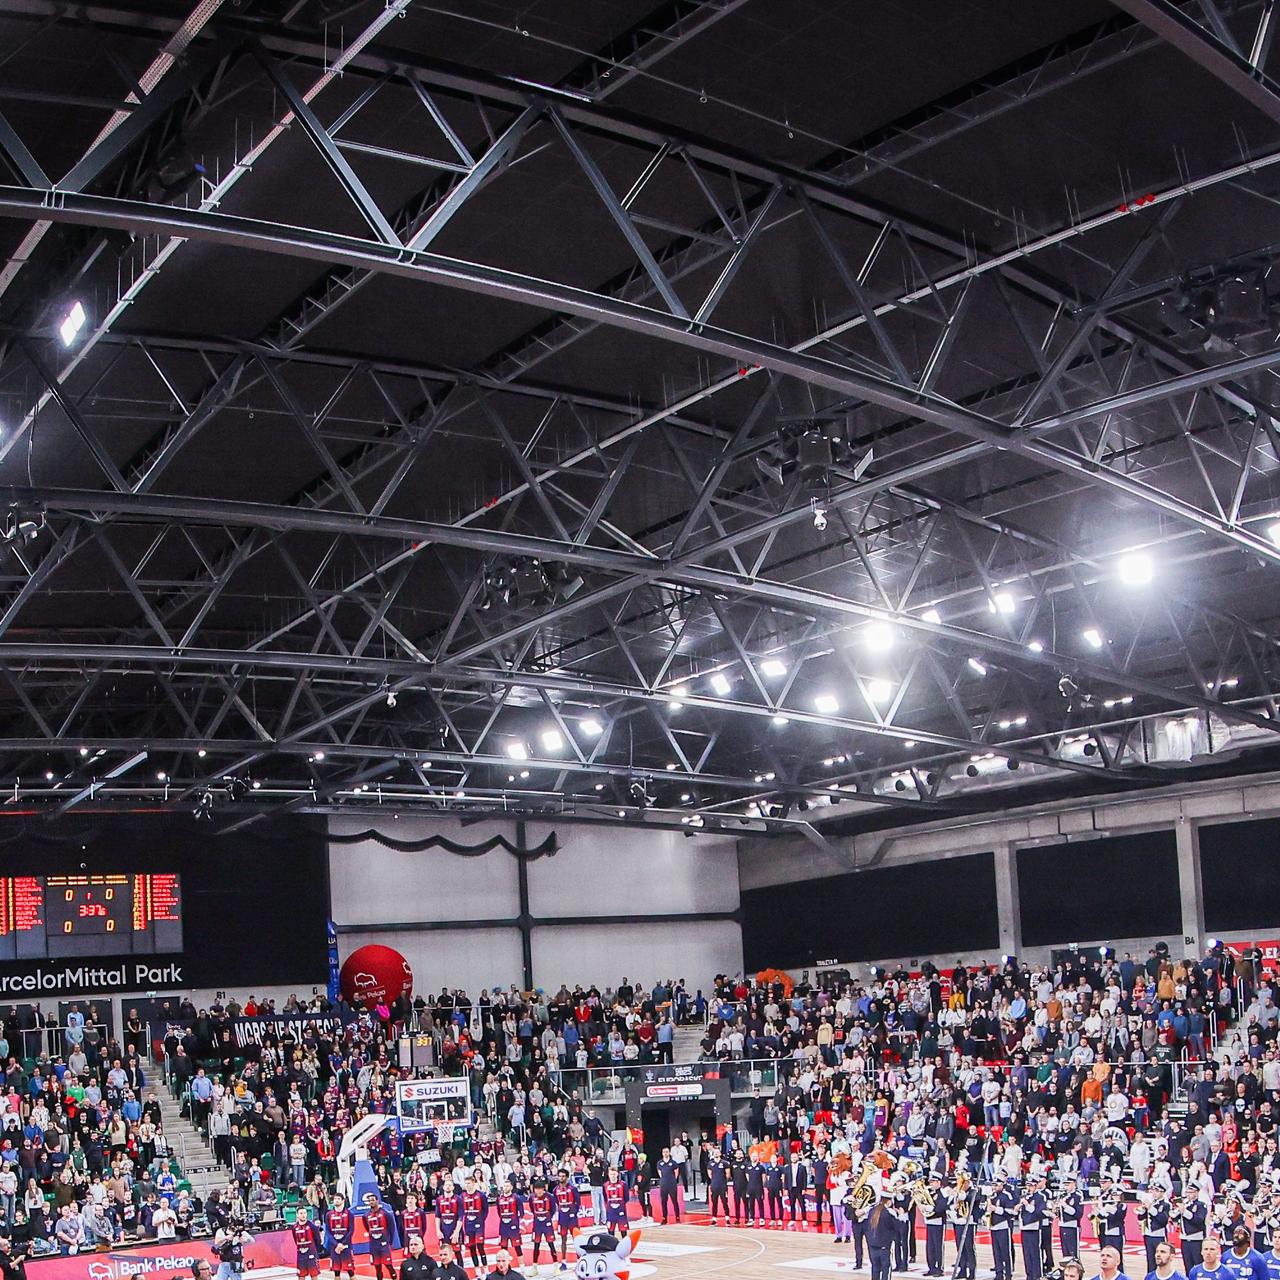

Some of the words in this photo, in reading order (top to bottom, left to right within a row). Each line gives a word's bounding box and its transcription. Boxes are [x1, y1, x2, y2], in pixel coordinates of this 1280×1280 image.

[65, 890, 73, 901] 0
[105, 889, 113, 900] 0
[64, 921, 72, 932] 0
[106, 920, 114, 931] 0
[1185, 936, 1195, 945] B4
[136, 963, 182, 984] Park
[416, 1086, 459, 1096] SUZUKI
[120, 1258, 153, 1276] Bank
[155, 1255, 195, 1272] Pekao
